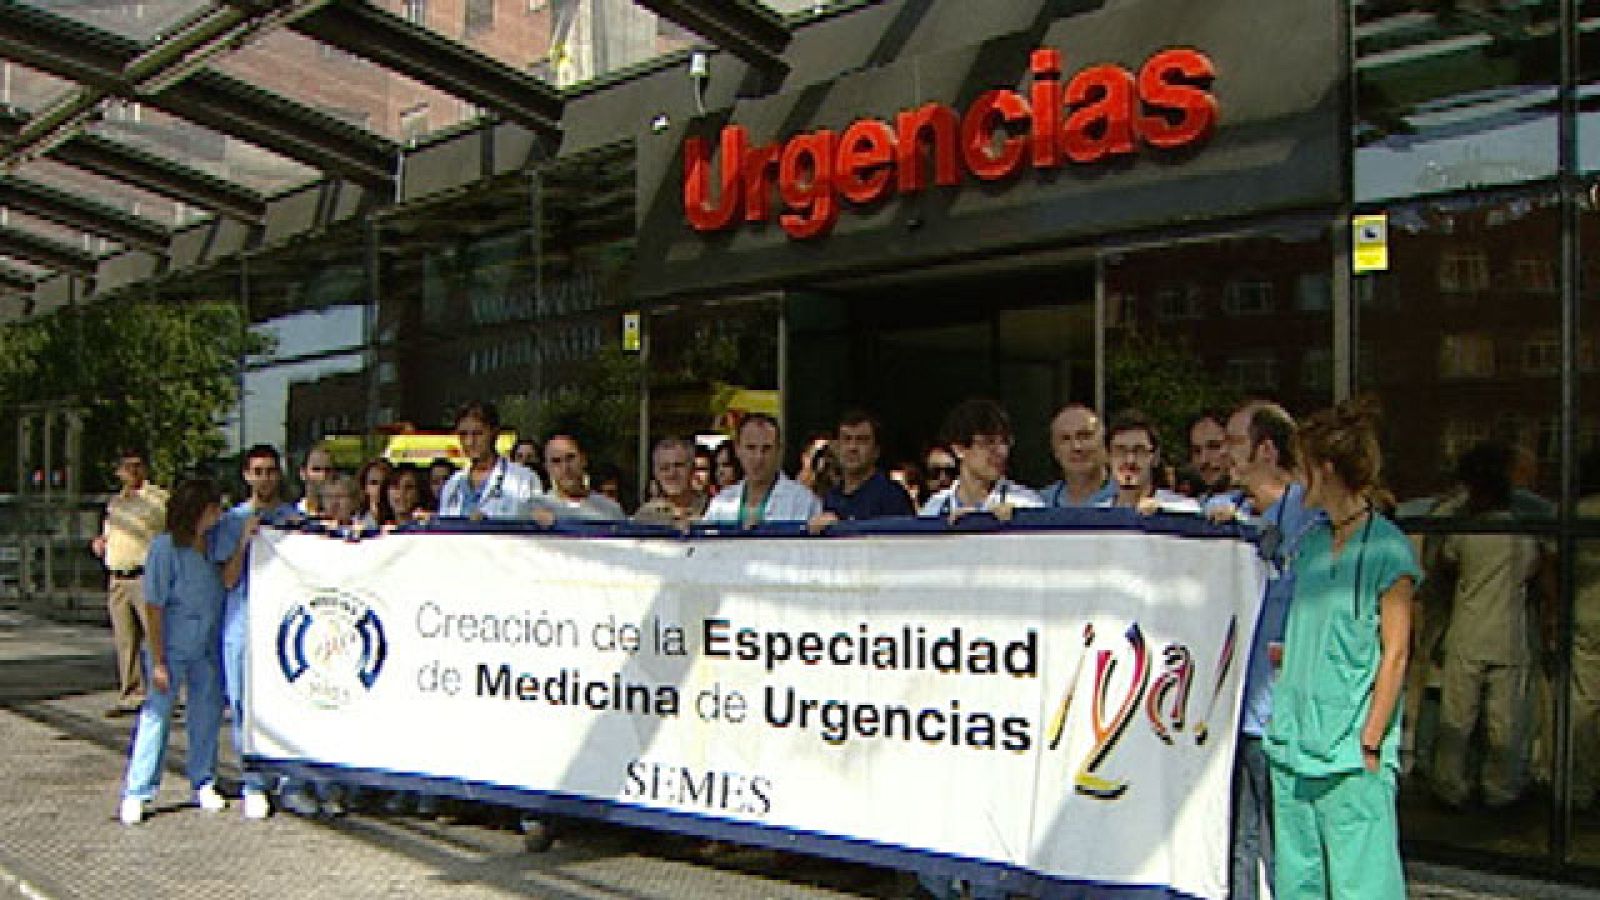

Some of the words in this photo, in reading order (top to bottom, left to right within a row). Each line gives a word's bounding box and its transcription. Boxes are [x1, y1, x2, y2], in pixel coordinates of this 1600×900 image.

[684, 47, 1219, 238] Urgencias
[415, 601, 579, 648] Creación
[592, 614, 641, 653] de
[653, 616, 687, 656] la
[702, 618, 1038, 678] Especialidad
[417, 660, 461, 695] de
[475, 662, 681, 717] Medicina
[696, 683, 748, 723] de
[763, 686, 1032, 752] Urgencias
[624, 759, 772, 816] SEMES
